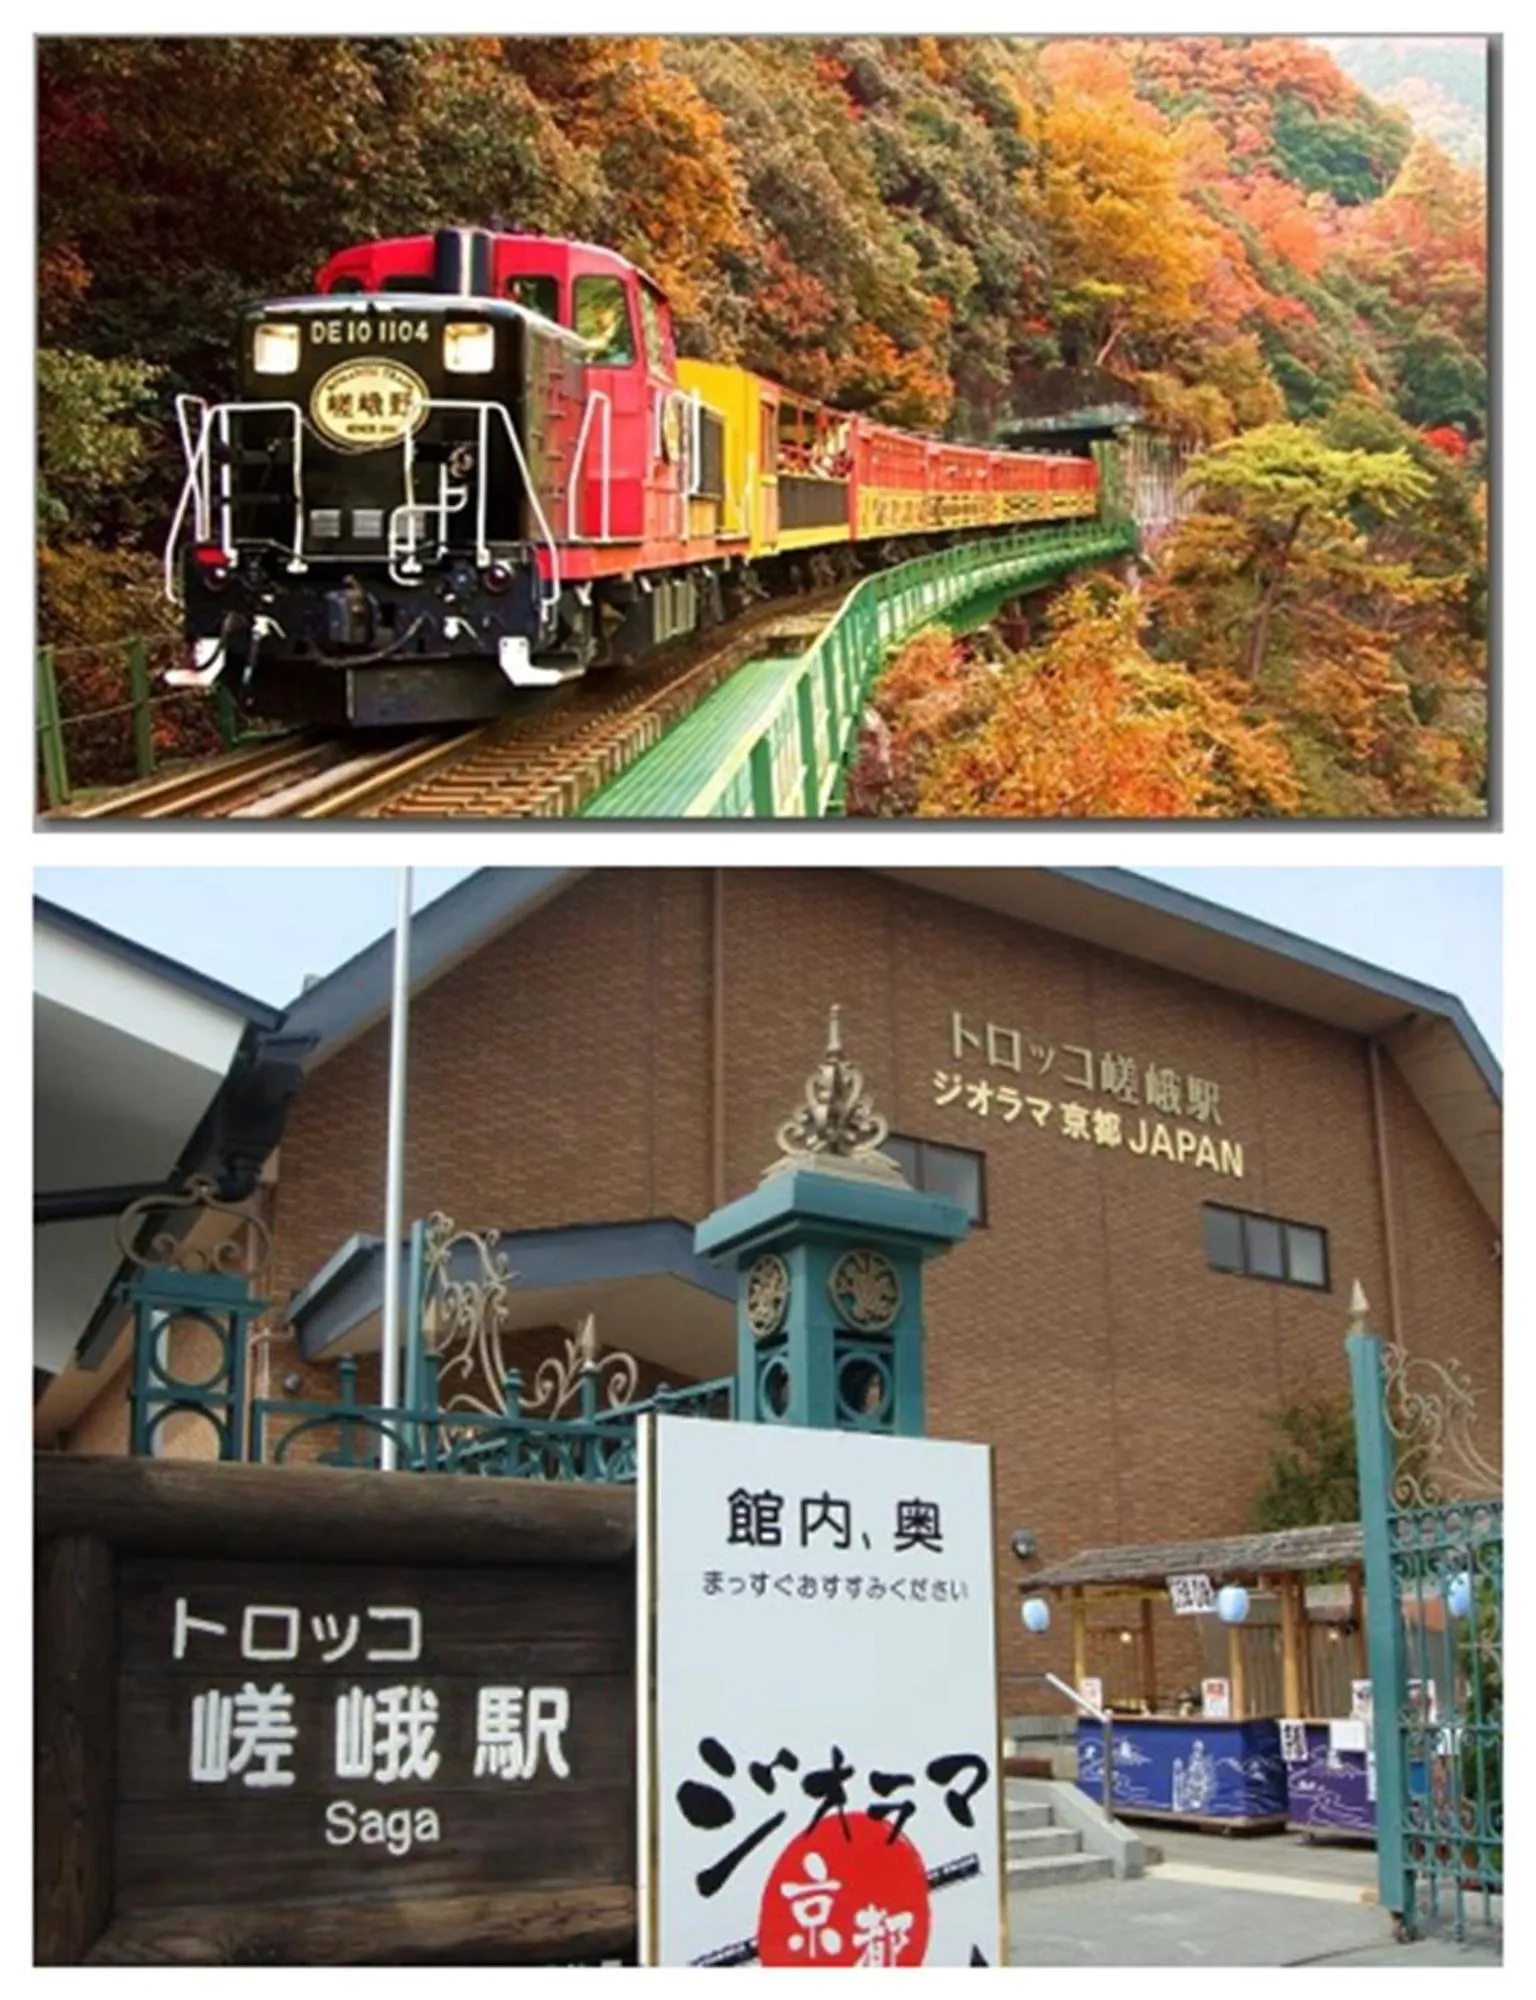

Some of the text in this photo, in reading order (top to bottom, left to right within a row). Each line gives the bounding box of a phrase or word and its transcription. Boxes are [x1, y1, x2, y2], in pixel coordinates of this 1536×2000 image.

[378, 320, 429, 343] 1104
[952, 1011, 1222, 1126] トロッコ嵯峨駅
[1128, 1119, 1244, 1178] JAPAN
[702, 1570, 969, 1602] まっすぐおすすみください
[171, 1598, 422, 1662] トロッコ
[189, 1682, 571, 1787] 嵯峨駅
[324, 1801, 441, 1855] Saga
[677, 1737, 989, 1898] ジオラマ
[780, 1851, 914, 1967] 京都
